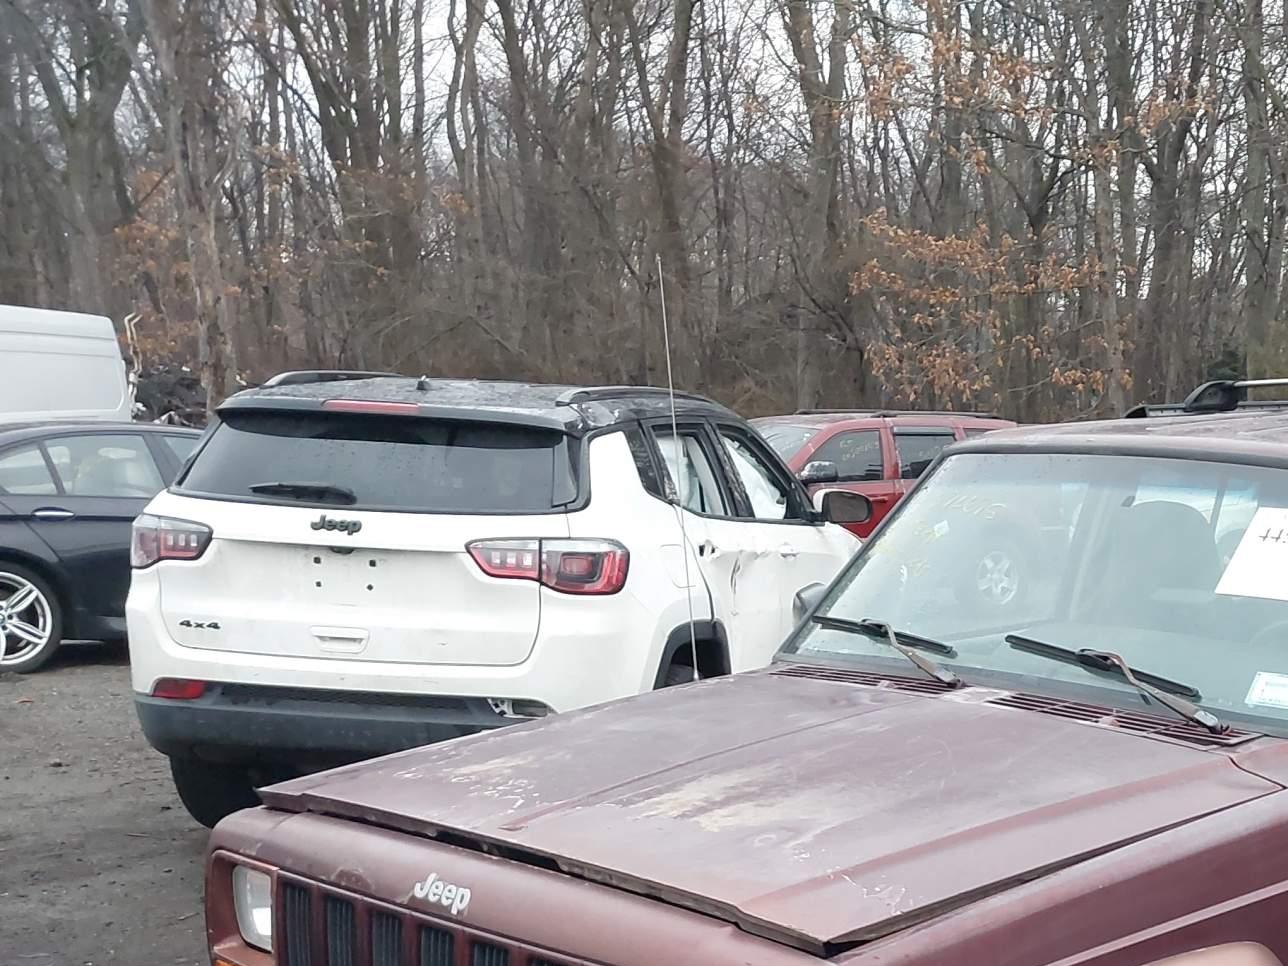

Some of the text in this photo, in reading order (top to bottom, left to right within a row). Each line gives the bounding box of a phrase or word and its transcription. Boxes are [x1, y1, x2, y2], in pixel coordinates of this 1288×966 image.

[309, 514, 363, 536] Jeep
[178, 618, 222, 631] 4x4
[412, 872, 471, 915] Jeep
